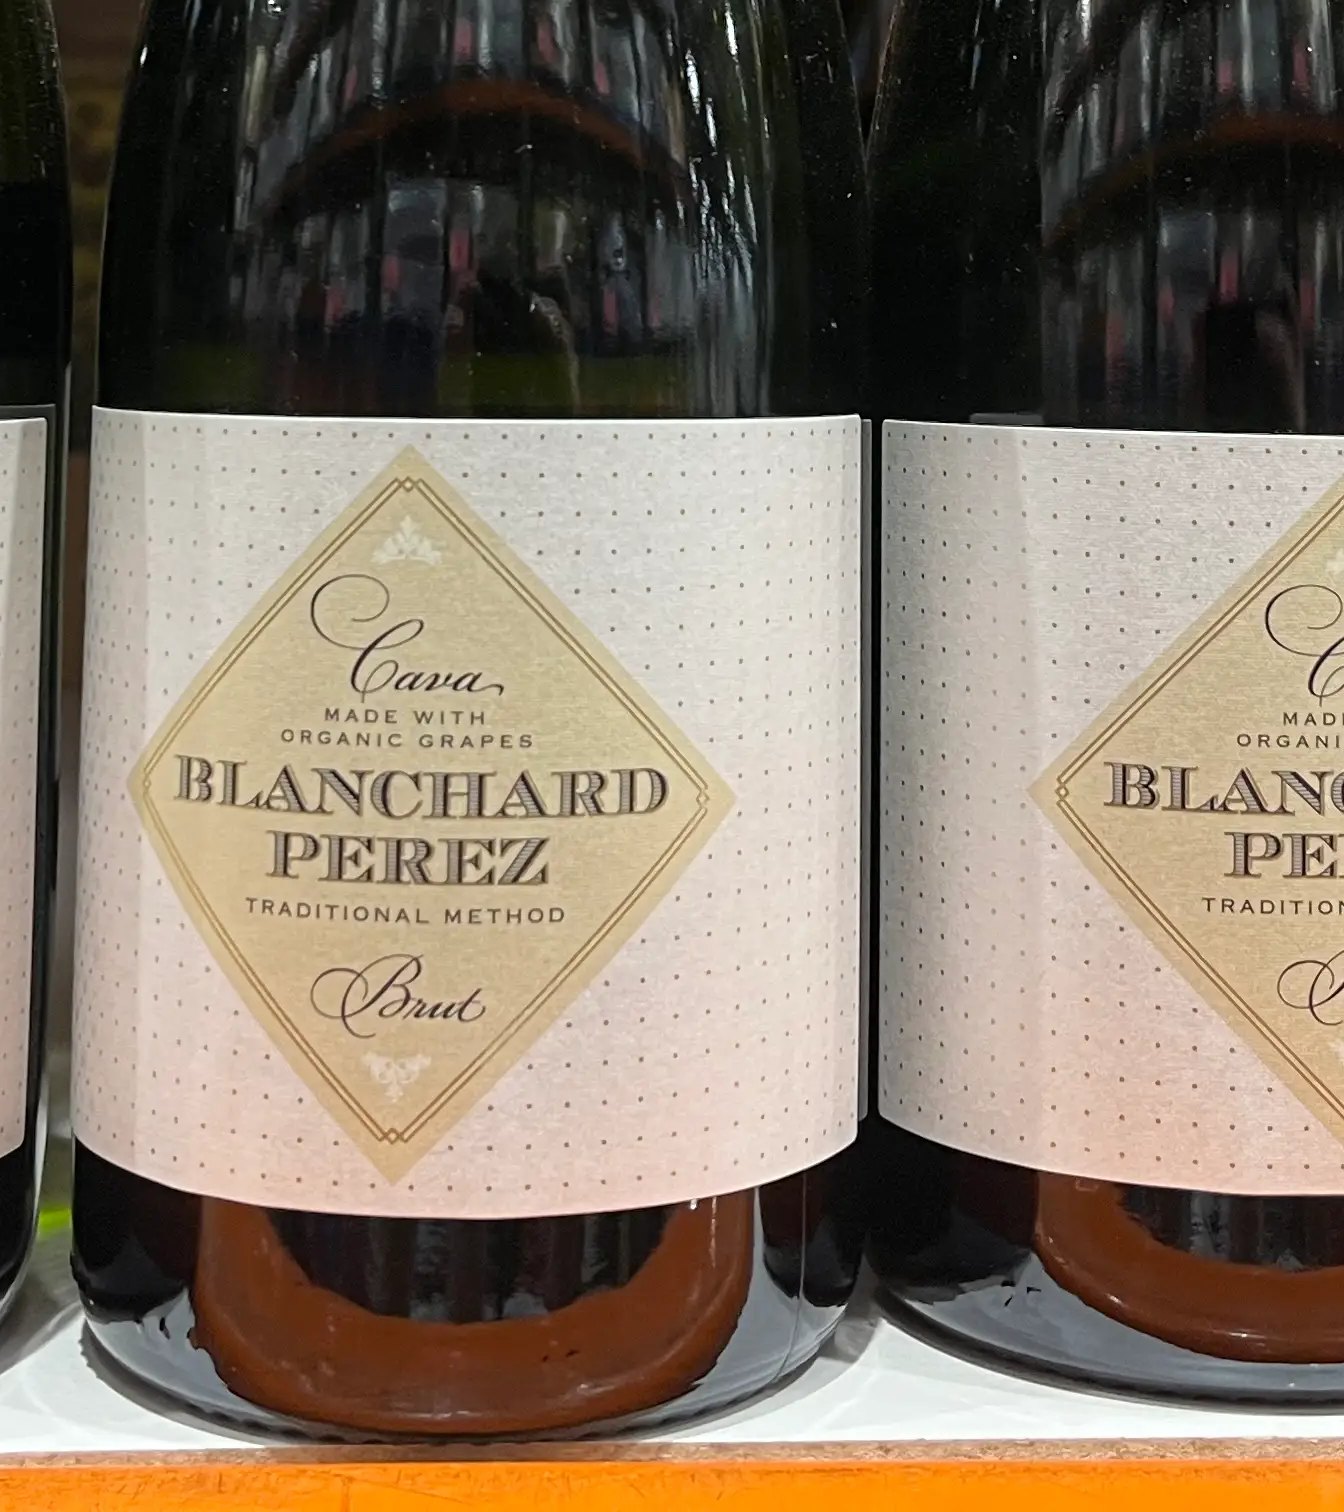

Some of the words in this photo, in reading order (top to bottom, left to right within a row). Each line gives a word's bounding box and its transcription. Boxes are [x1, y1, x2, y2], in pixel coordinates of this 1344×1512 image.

[310, 574, 504, 703] Cava
[280, 729, 403, 748] ORGANIC
[419, 733, 534, 749] GRAPES
[324, 707, 398, 725] MADE
[413, 709, 486, 726] WITH
[172, 754, 670, 819] BLANCHARD
[265, 829, 551, 886] PEREZ
[245, 897, 430, 924] TRADITIONAL
[444, 907, 565, 925] METHOD
[310, 953, 487, 1039] Brut
